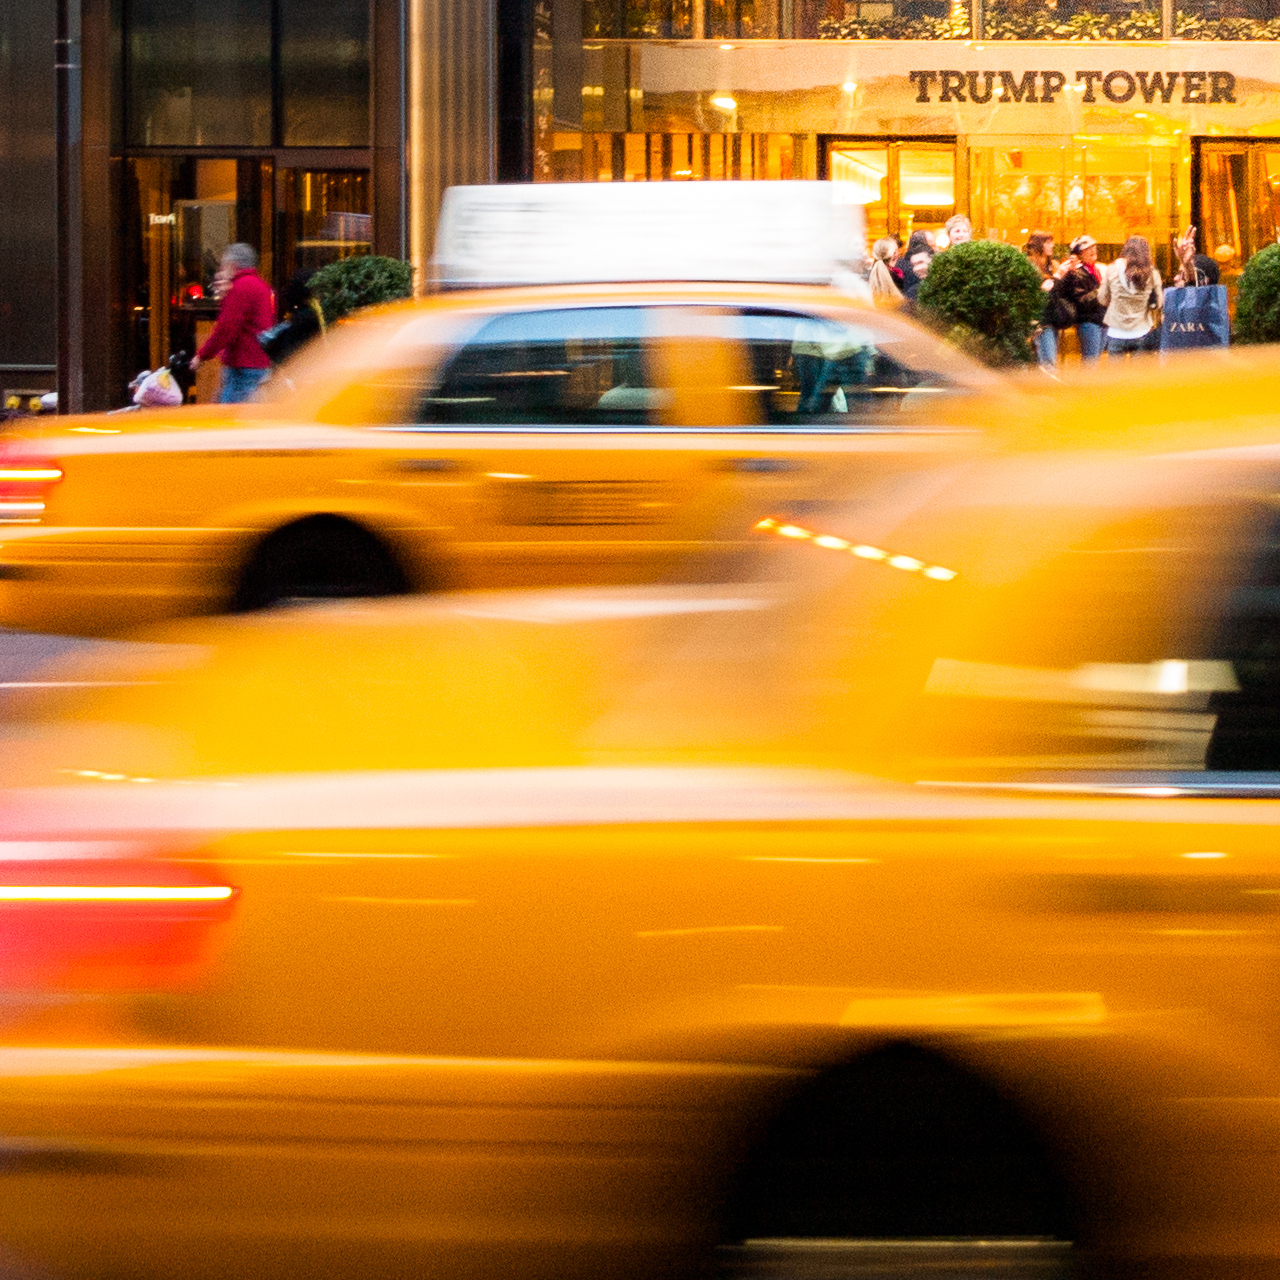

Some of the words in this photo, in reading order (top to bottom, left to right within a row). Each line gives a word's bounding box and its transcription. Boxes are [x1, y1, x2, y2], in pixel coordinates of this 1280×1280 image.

[909, 70, 1066, 104] TRUMP
[1075, 70, 1237, 104] TOWER
[1169, 321, 1205, 333] ZARA
